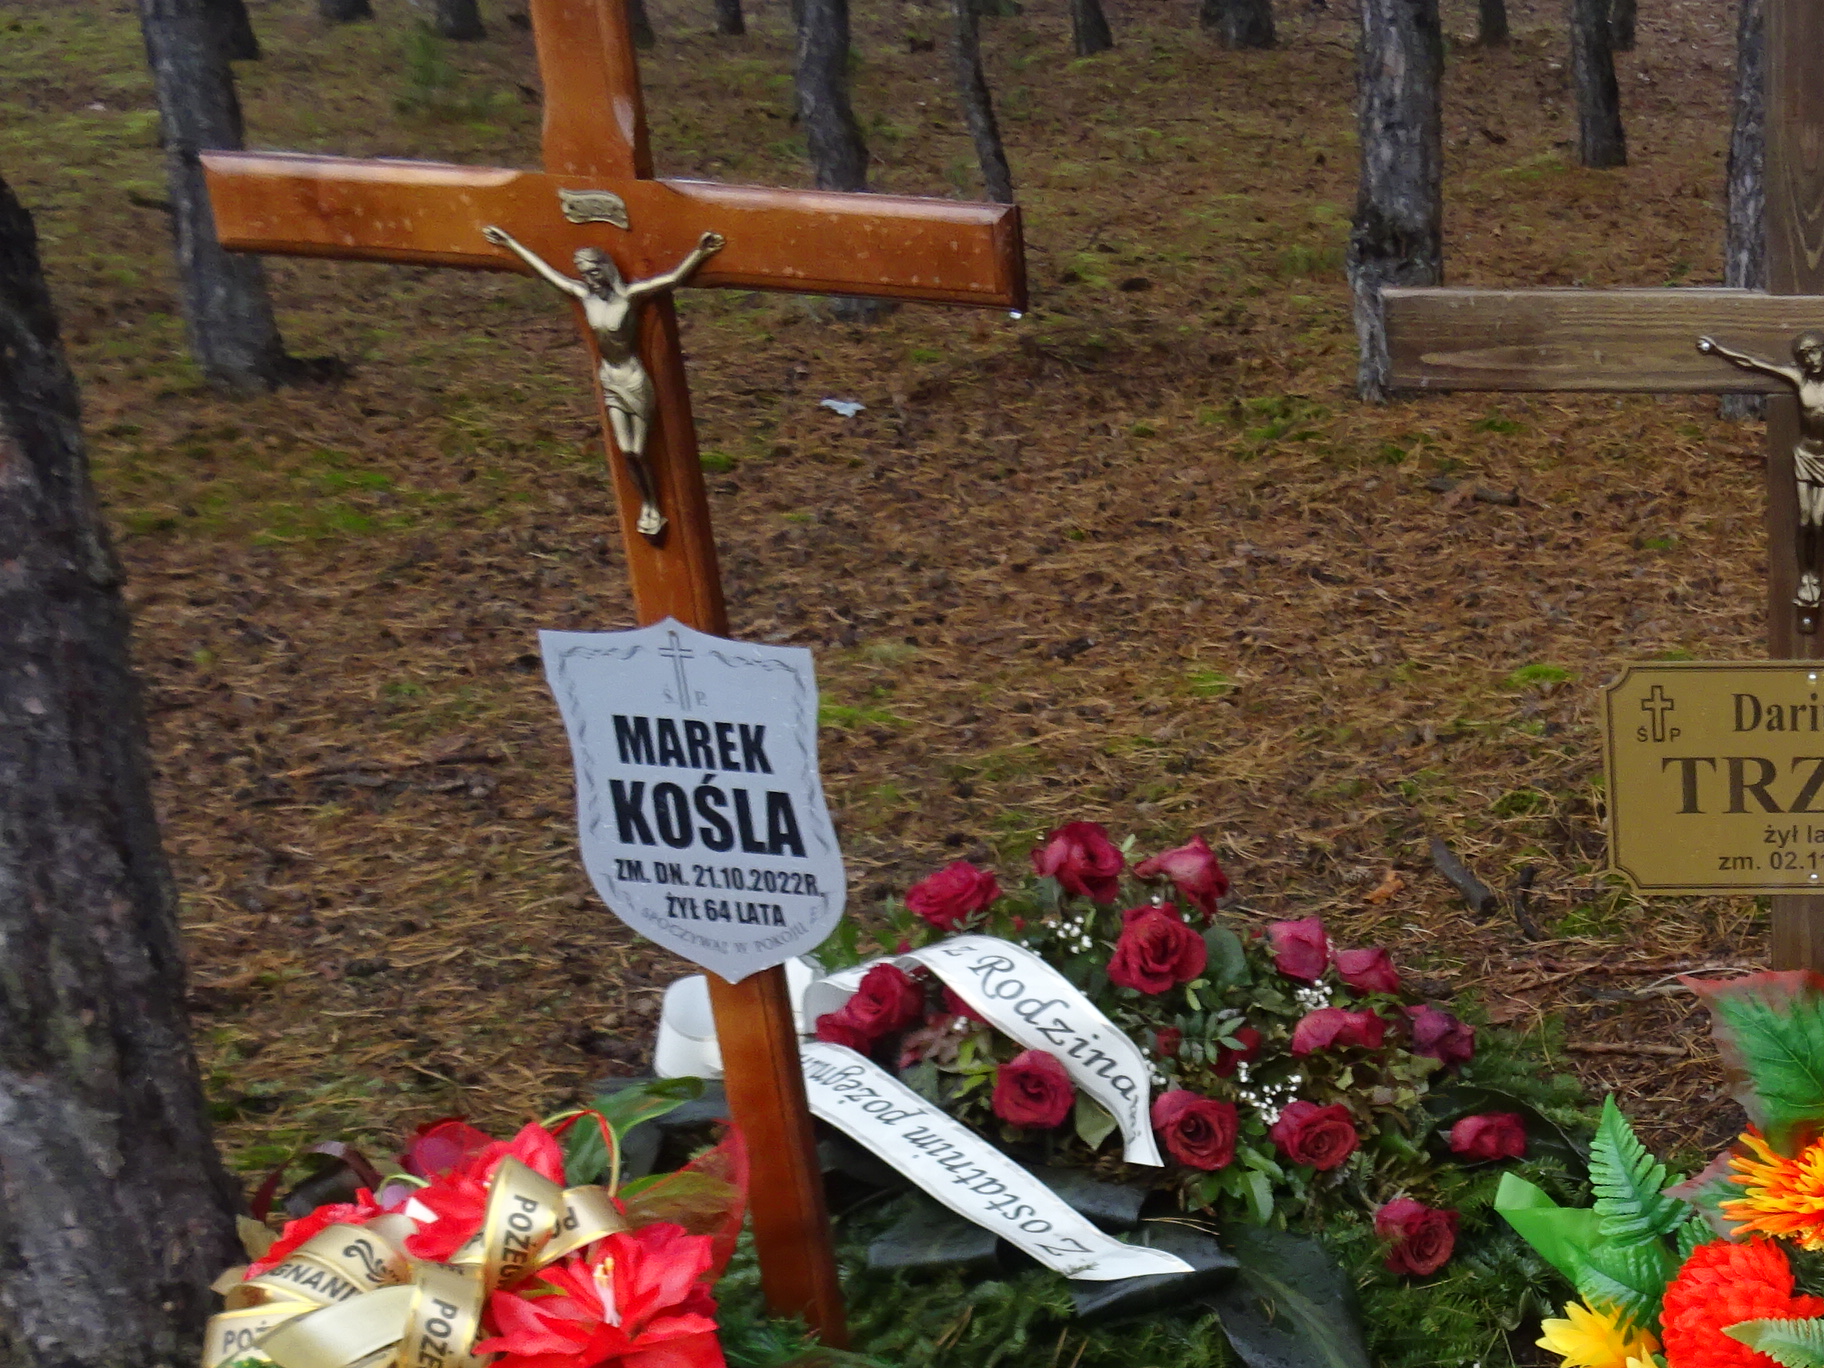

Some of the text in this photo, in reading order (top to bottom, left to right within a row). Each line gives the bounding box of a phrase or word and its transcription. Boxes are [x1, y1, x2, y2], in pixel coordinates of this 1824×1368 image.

[612, 714, 774, 775] MAREK
[608, 773, 808, 858] KOŚLA
[1763, 825, 1799, 849] żył
[614, 858, 650, 884] ZM.
[653, 861, 689, 887] DN.
[1718, 855, 1761, 871] zm.
[665, 891, 787, 928] ŻYŁ 64 LATA
[901, 1125, 1052, 1236] ostatnim
